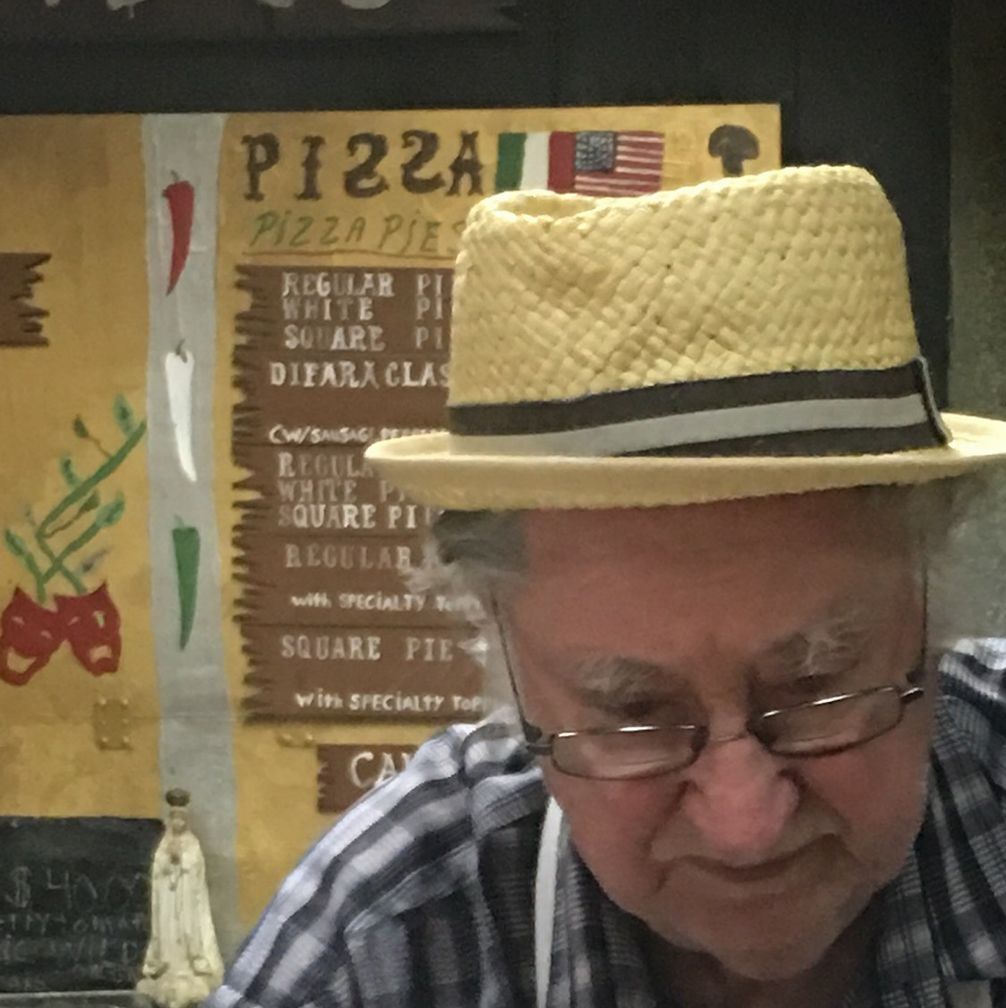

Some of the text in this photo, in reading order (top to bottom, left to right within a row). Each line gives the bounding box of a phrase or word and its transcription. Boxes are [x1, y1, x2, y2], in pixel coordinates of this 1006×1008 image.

[281, 271, 395, 298] REGULAR
[281, 297, 374, 321] WHITE
[283, 324, 387, 352] SQUARE
[277, 479, 358, 503] WHITE
[277, 503, 377, 529] SQUARE
[284, 544, 412, 569] REGULAR
[280, 635, 382, 661] SQUARE
